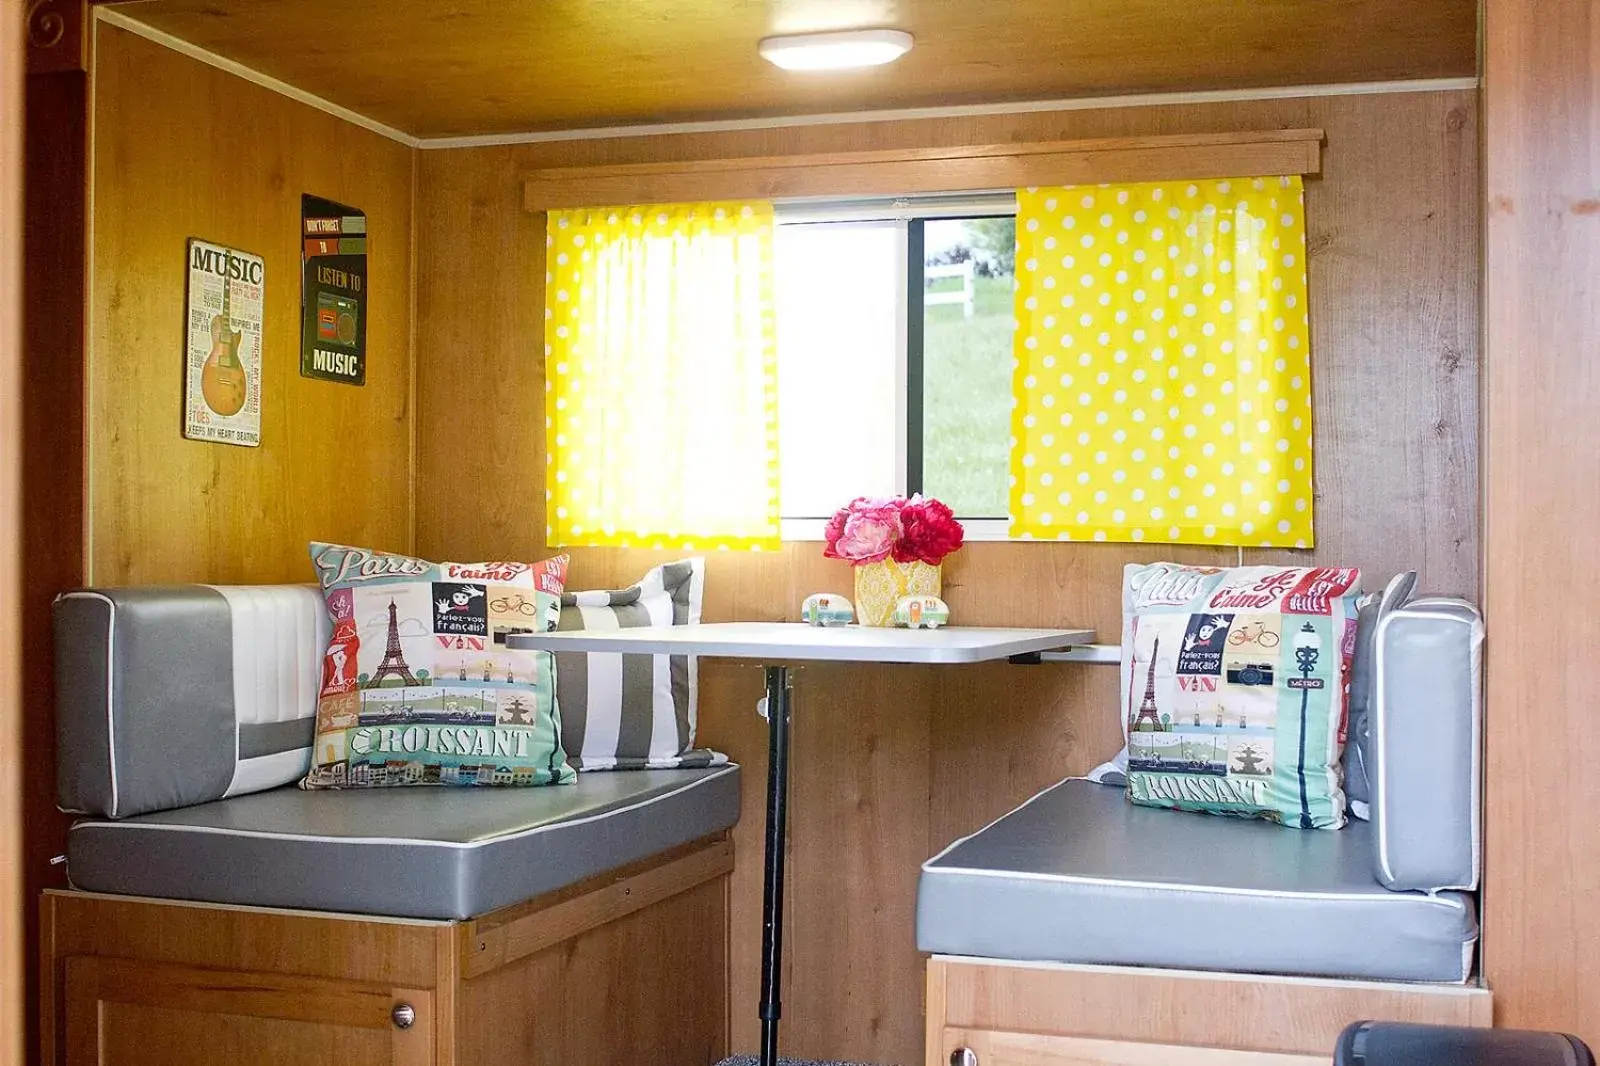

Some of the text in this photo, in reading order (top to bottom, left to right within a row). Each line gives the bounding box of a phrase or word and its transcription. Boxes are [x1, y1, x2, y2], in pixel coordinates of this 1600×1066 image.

[192, 246, 262, 286] MUSIC
[318, 265, 361, 291] LISTEN TO
[313, 348, 358, 377] MUSIC
[217, 428, 235, 439] HEART
[316, 549, 434, 590] Paris
[437, 620, 485, 632] français?
[1179, 659, 1219, 671] français?
[1181, 651, 1221, 660] Parlez-vous
